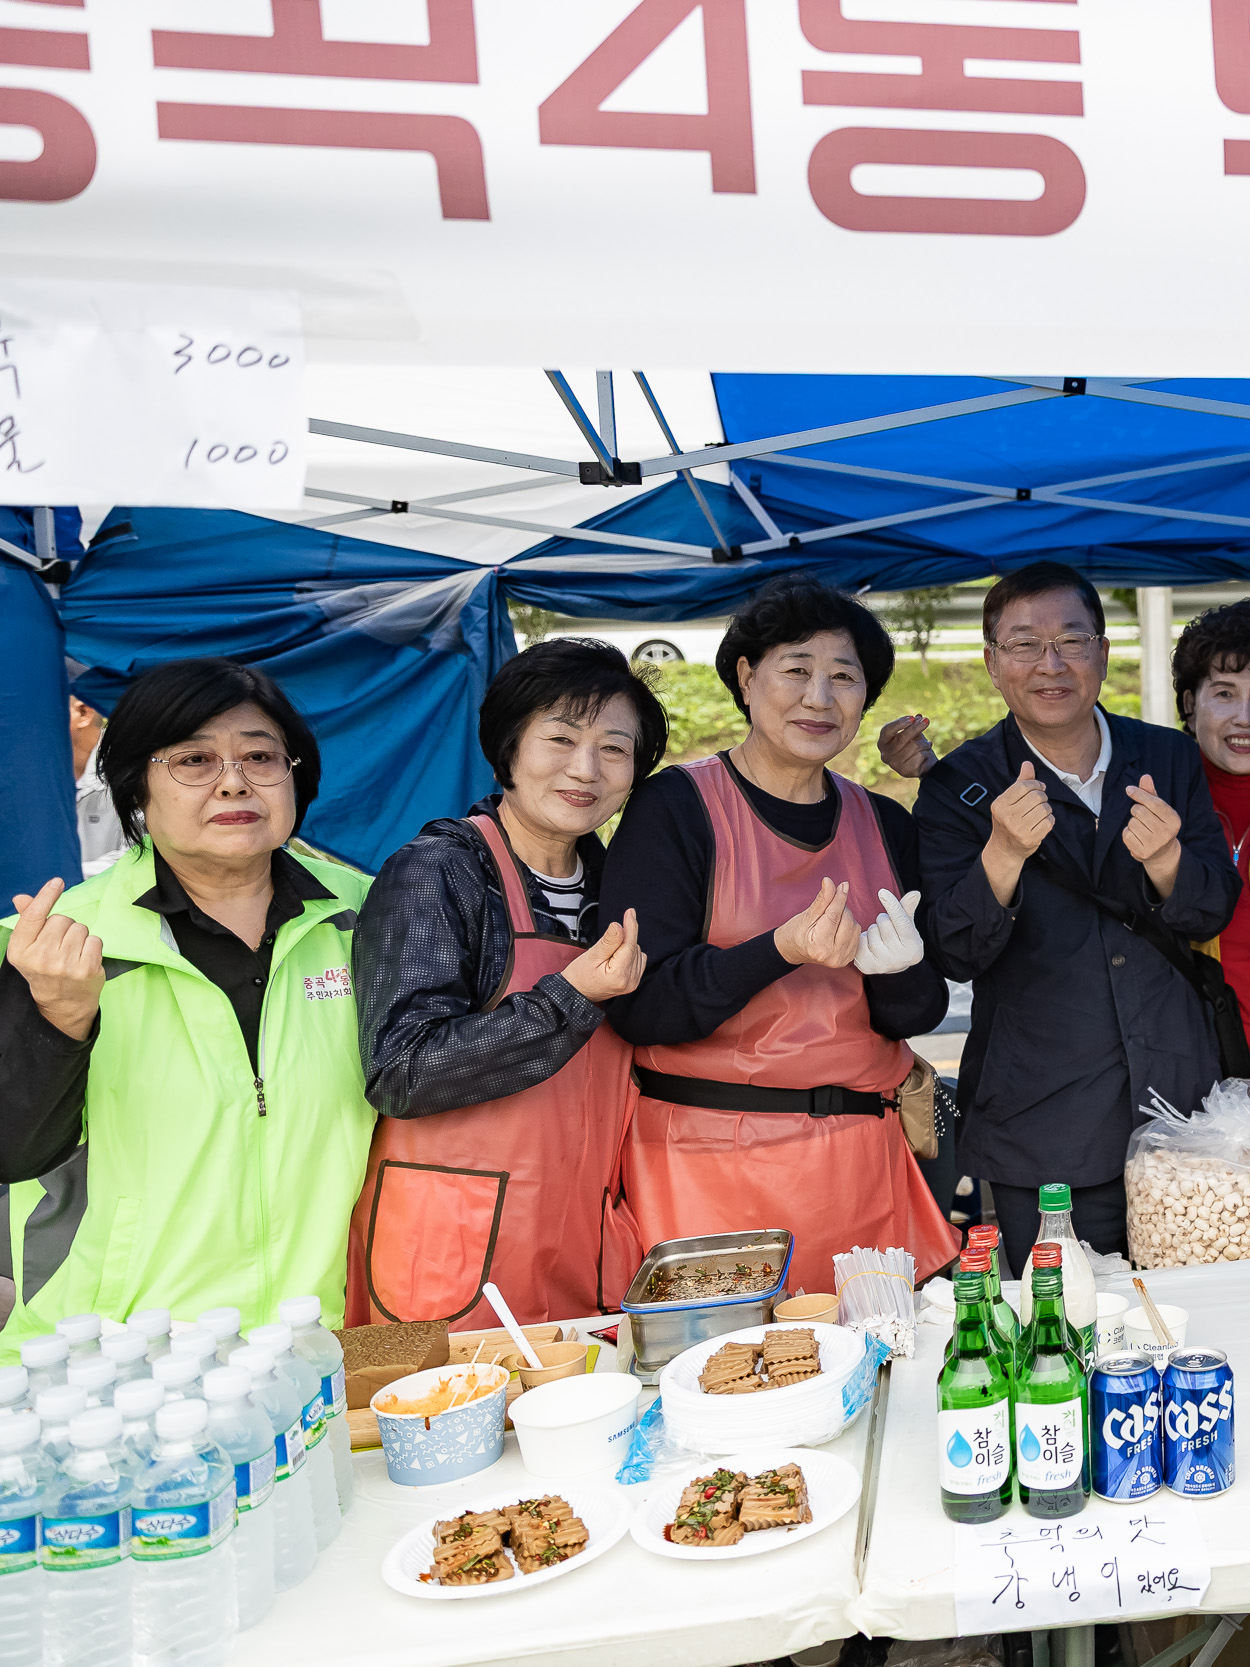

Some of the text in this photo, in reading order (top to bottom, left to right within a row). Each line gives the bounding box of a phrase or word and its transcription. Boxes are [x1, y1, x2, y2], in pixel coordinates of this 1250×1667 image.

[173, 332, 290, 375] 3000
[184, 438, 289, 469] 1000
[306, 987, 352, 1001] 주민자치회
[1103, 1391, 1161, 1450] Cas
[1181, 1430, 1218, 1452] FRESH
[977, 1470, 1002, 1486] fresh
[1045, 1469, 1071, 1482] fresh
[54, 1525, 100, 1542] 삼다수
[145, 1515, 193, 1532] 삼다수
[981, 1515, 1166, 1568] 추억의 맛
[1137, 1567, 1201, 1602] 있어요
